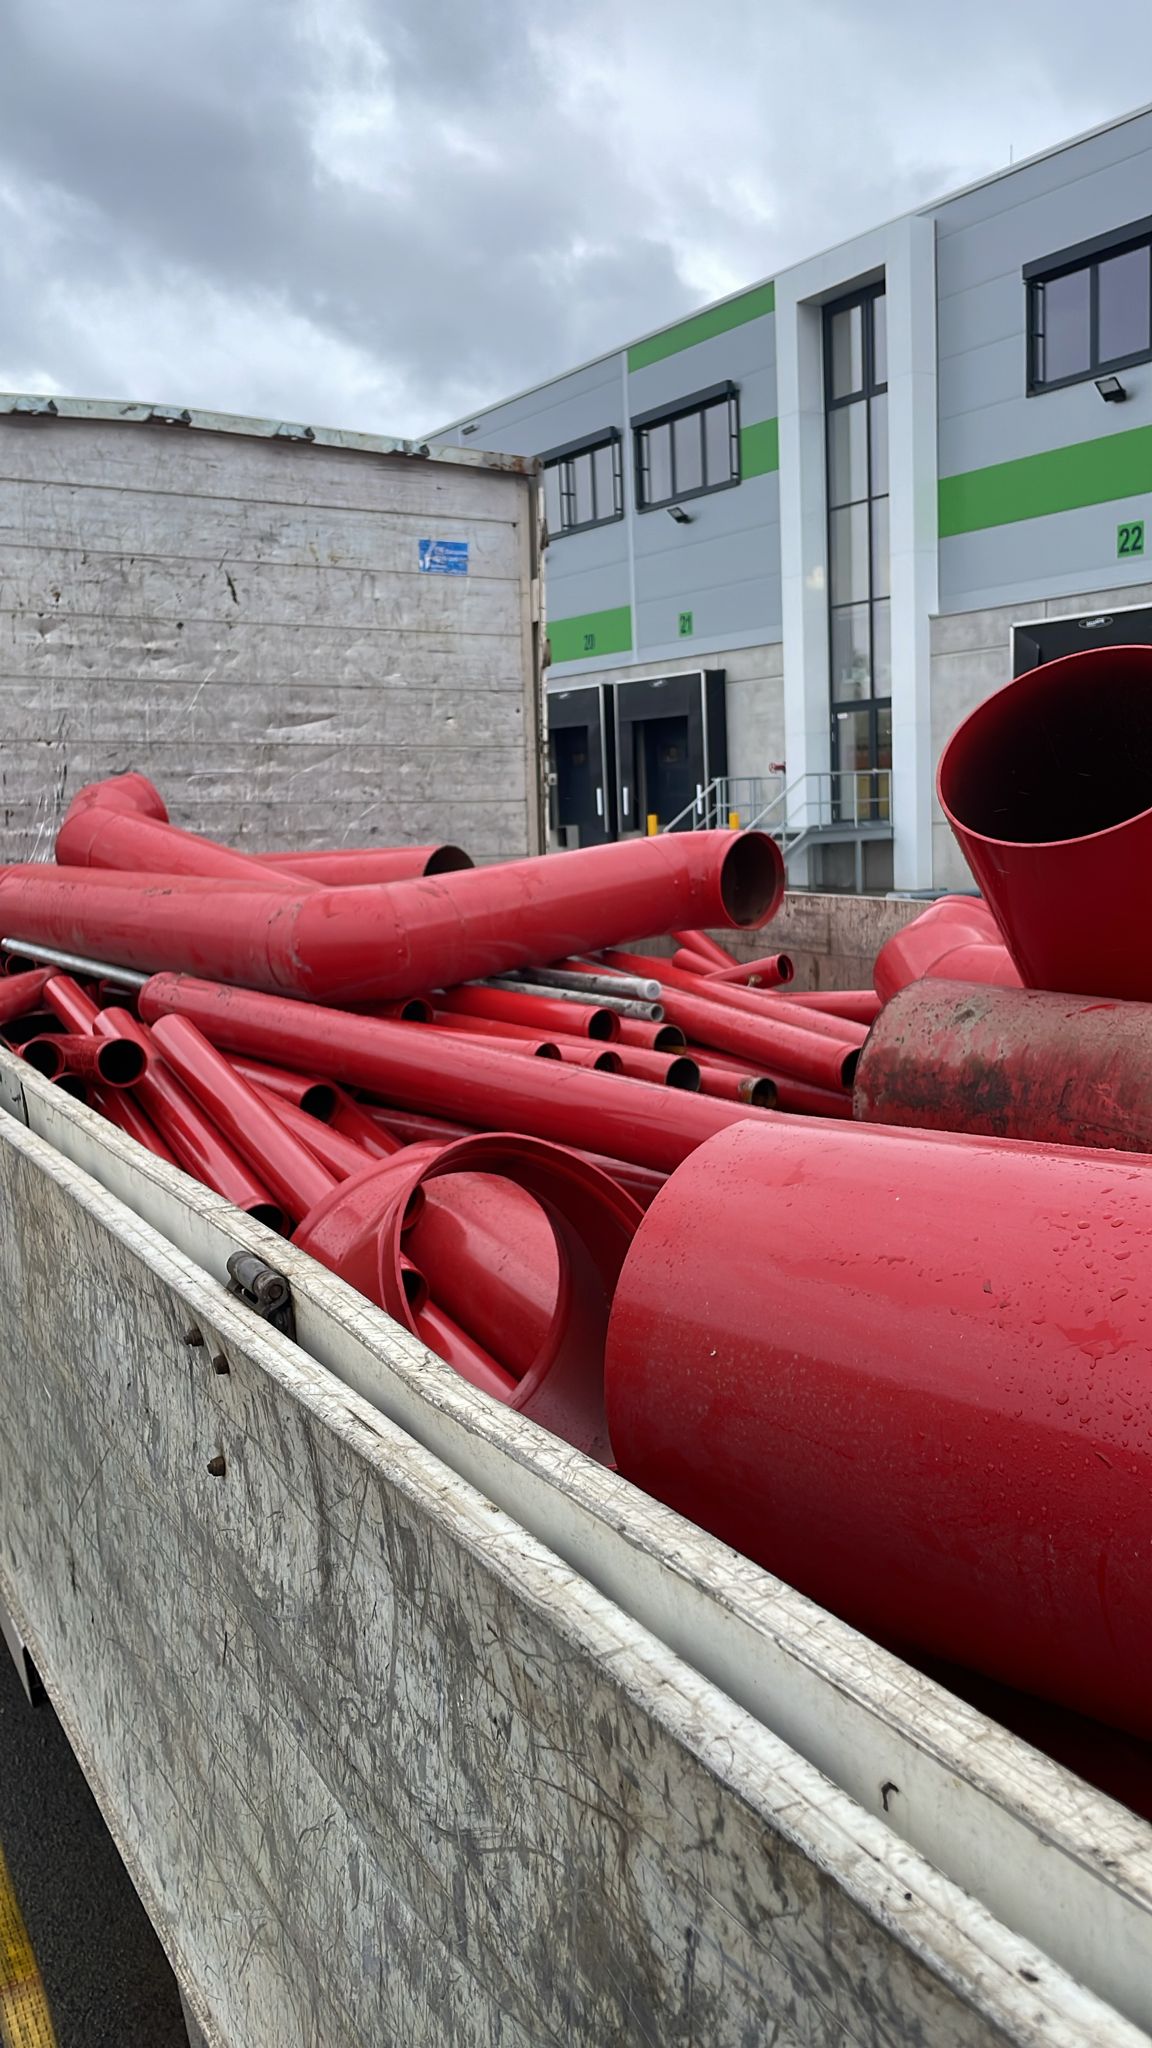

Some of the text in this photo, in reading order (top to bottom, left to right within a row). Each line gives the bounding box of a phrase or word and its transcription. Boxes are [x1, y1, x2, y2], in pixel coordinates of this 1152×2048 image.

[1119, 526, 1142, 553] 22
[679, 614, 692, 634] 21
[583, 634, 596, 651] 20
